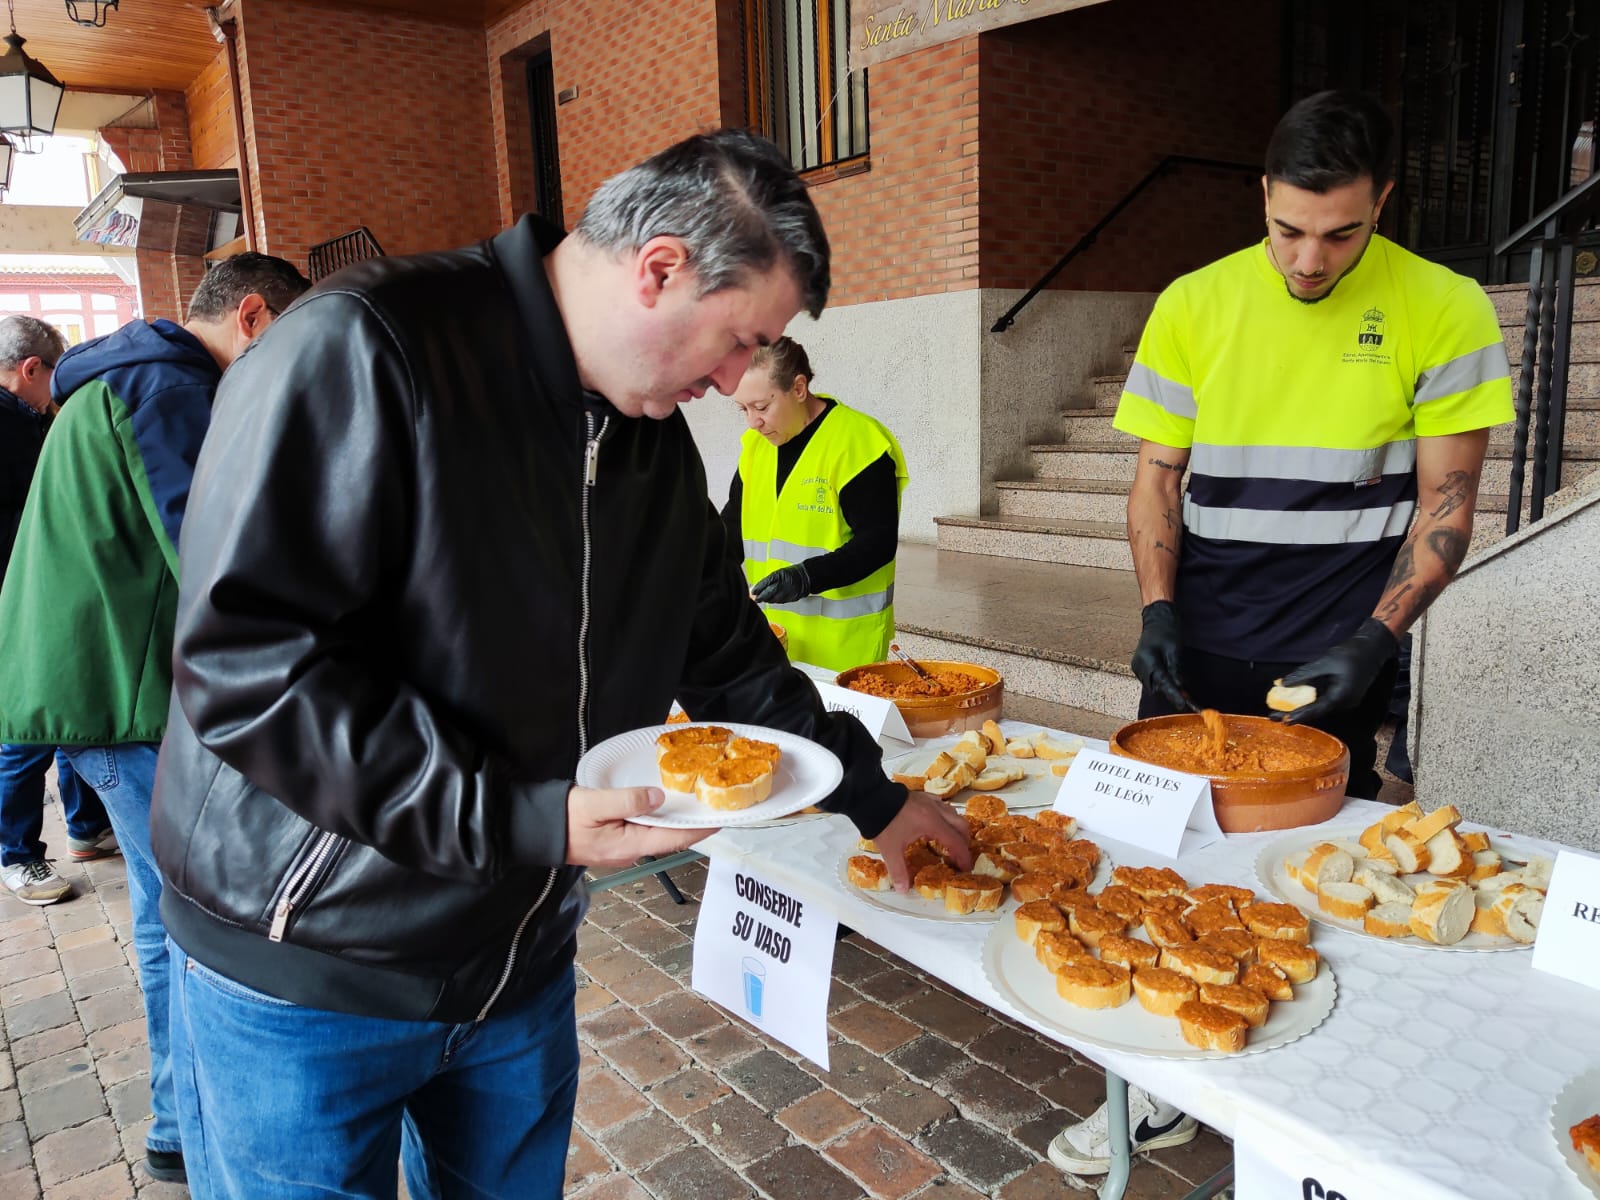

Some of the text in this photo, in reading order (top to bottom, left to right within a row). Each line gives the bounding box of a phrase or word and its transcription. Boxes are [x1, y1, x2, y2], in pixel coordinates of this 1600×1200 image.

[860, 8, 919, 50] Santa
[1087, 758, 1182, 793] HOTEL REYES
[1094, 780, 1154, 807] DE LEÓN
[735, 873, 804, 928] CONSERVE
[732, 910, 792, 964] SU VASO
